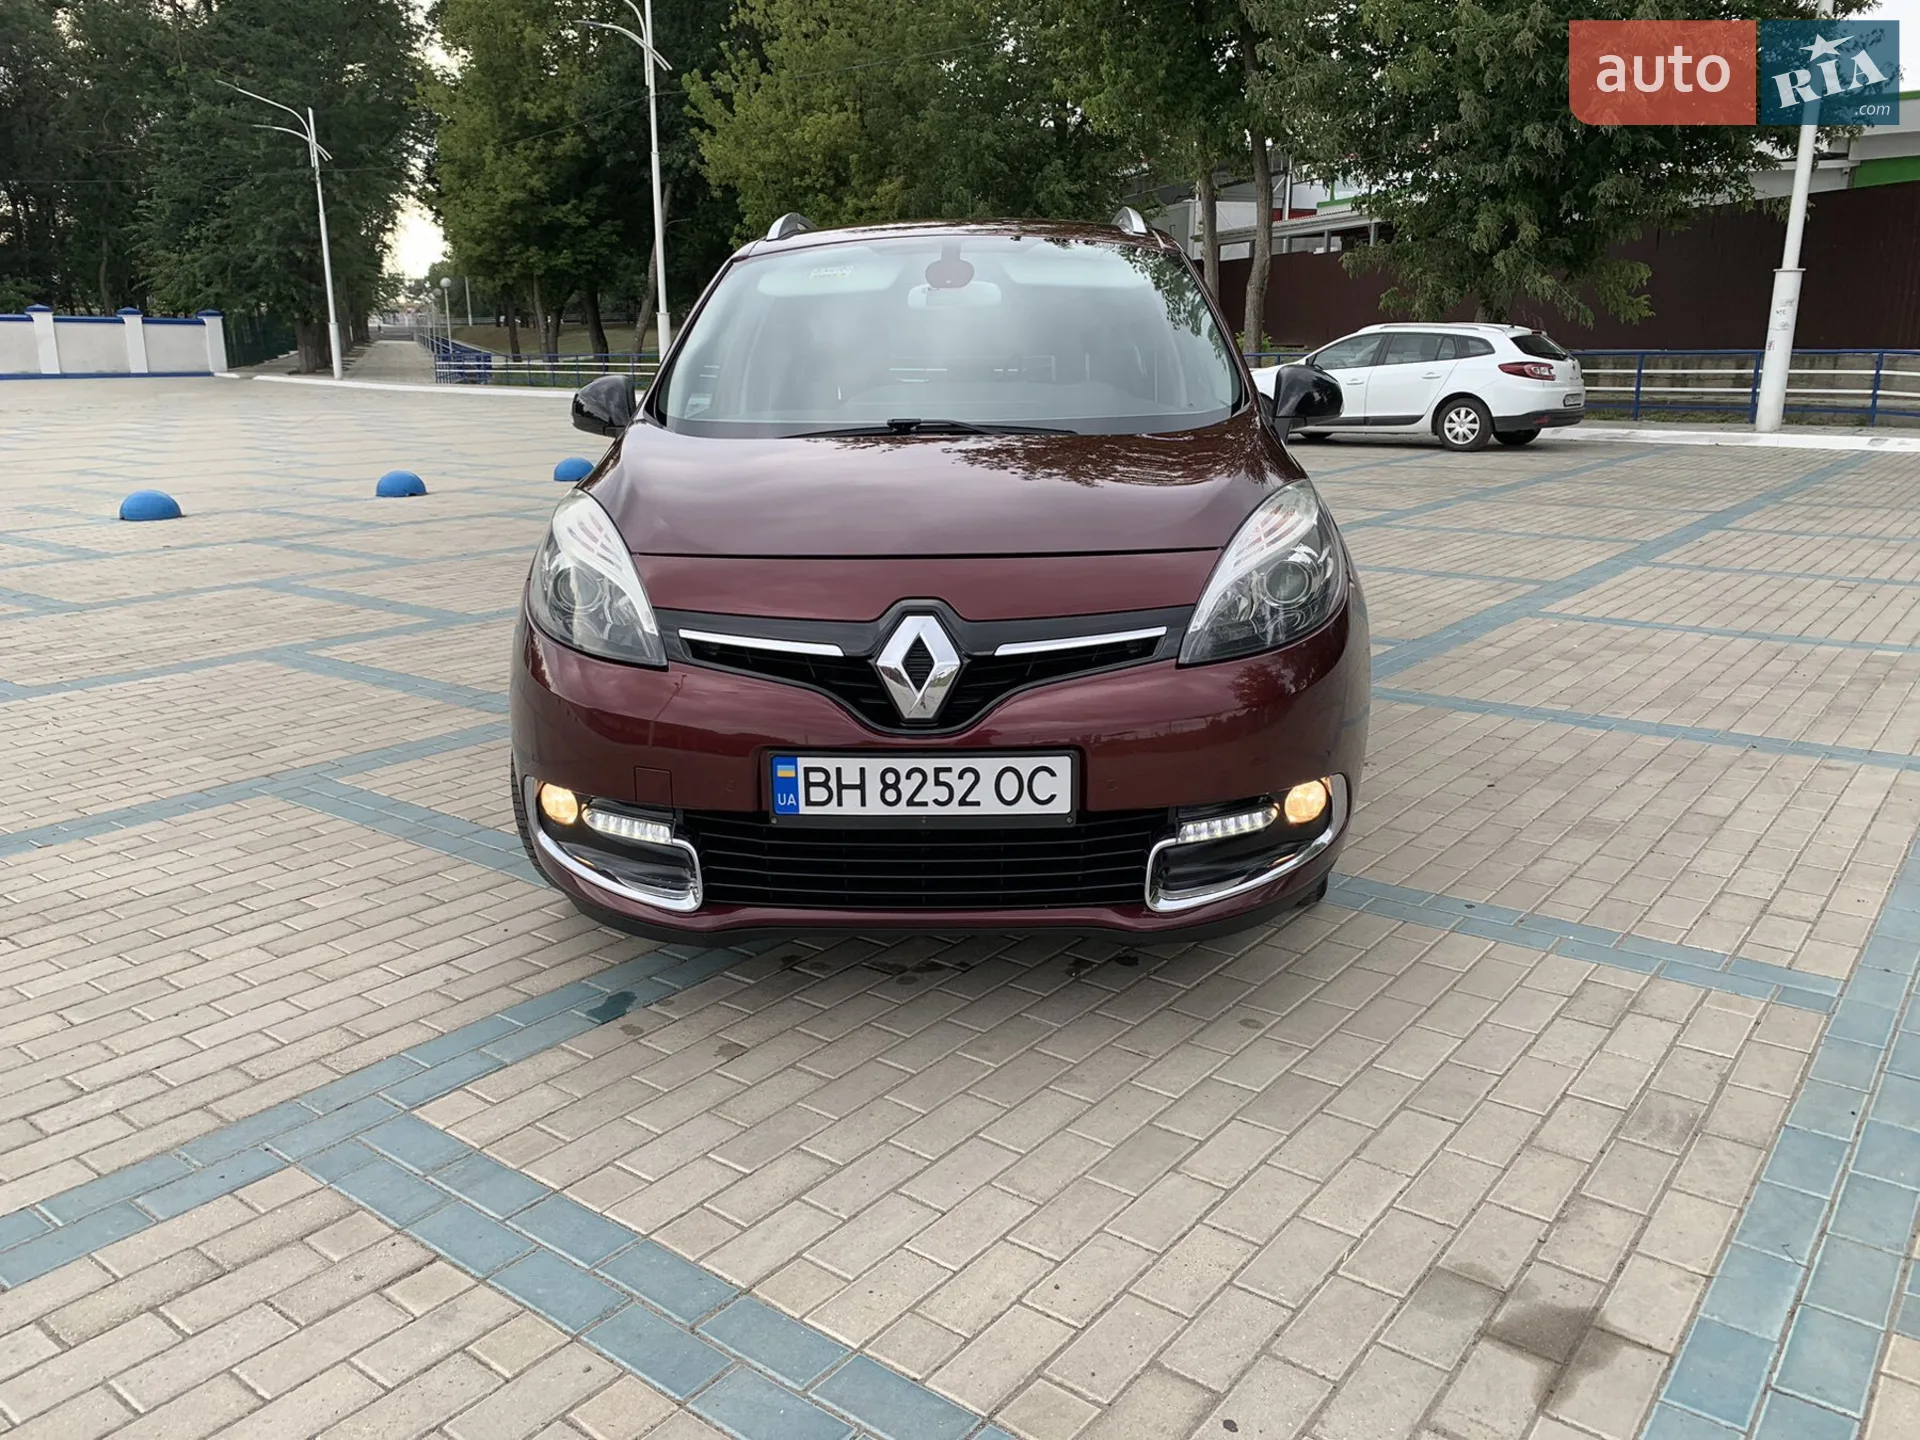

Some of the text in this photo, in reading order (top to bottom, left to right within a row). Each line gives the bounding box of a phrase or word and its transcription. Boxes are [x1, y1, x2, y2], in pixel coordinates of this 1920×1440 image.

[777, 793, 797, 806] UA
[803, 765, 1058, 808] BH 8252 OC
